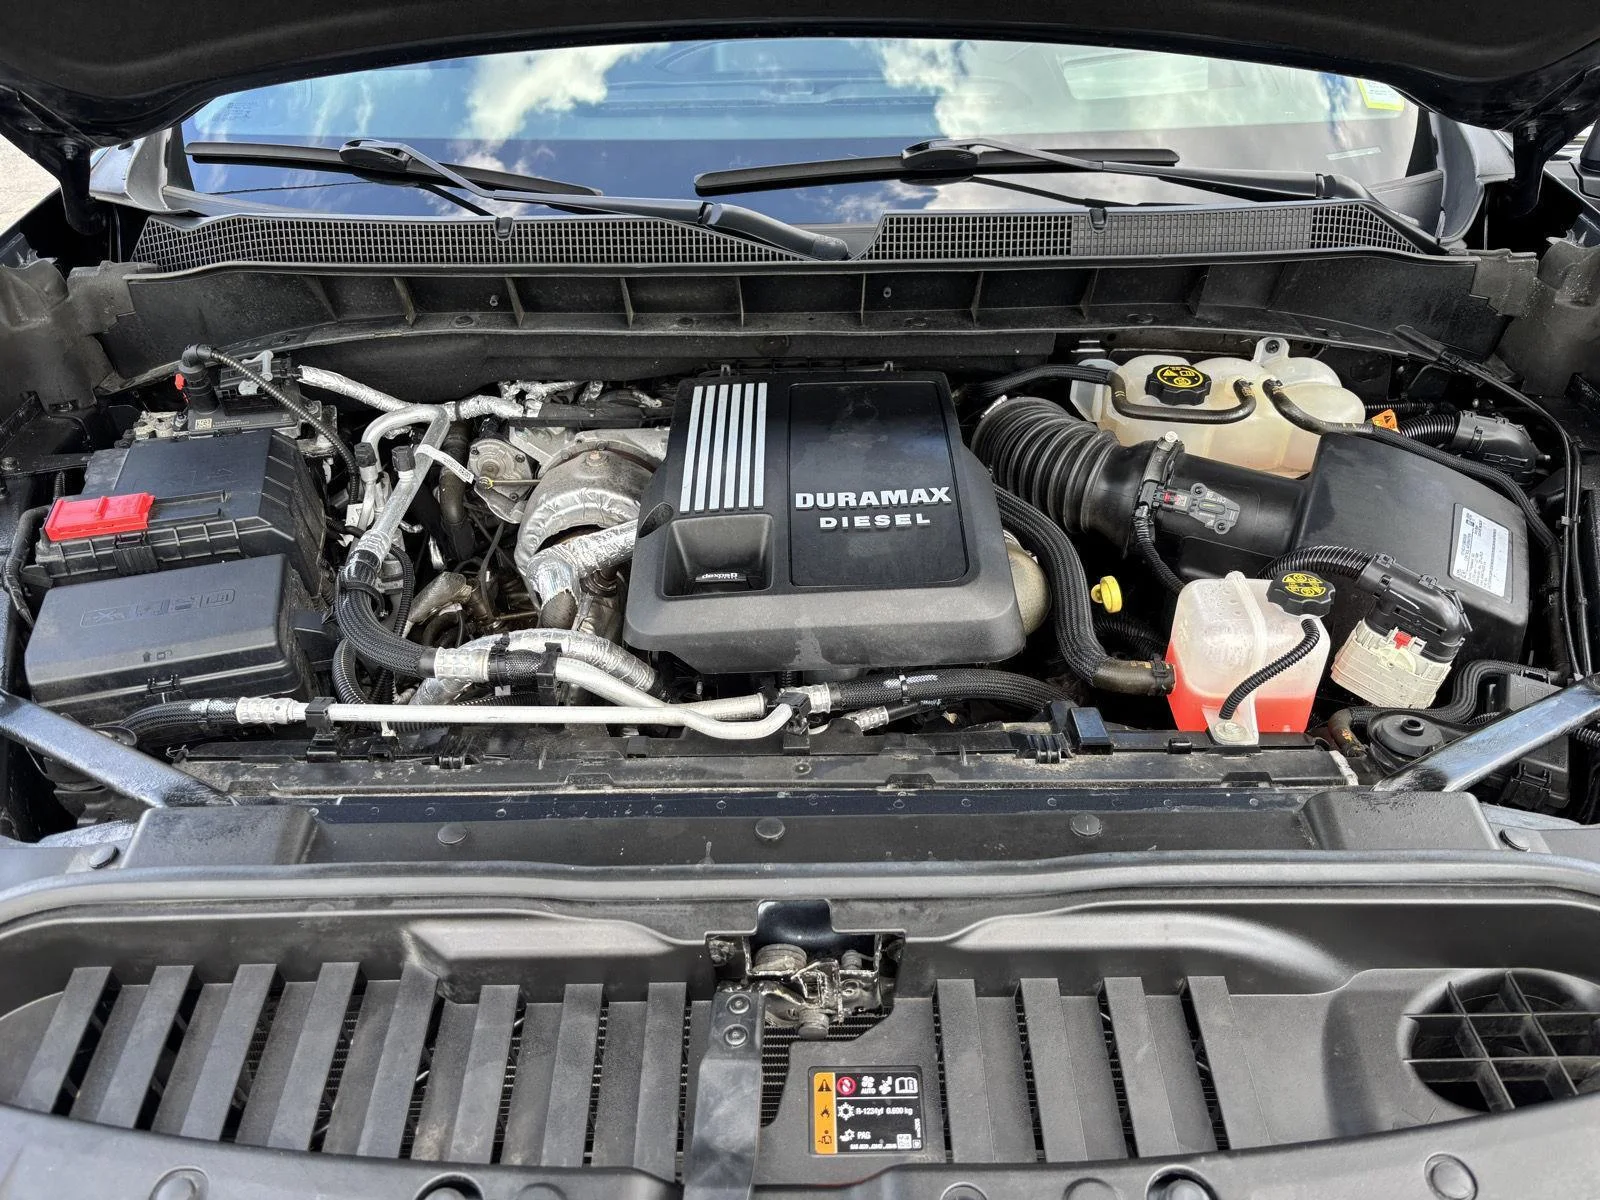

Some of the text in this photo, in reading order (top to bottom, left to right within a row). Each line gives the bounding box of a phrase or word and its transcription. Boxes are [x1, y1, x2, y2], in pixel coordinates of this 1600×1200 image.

[795, 486, 952, 509] DURAMAX
[819, 513, 931, 530] DIESEL
[904, 1107, 913, 1116] kg
[857, 1131, 871, 1140] PAG
